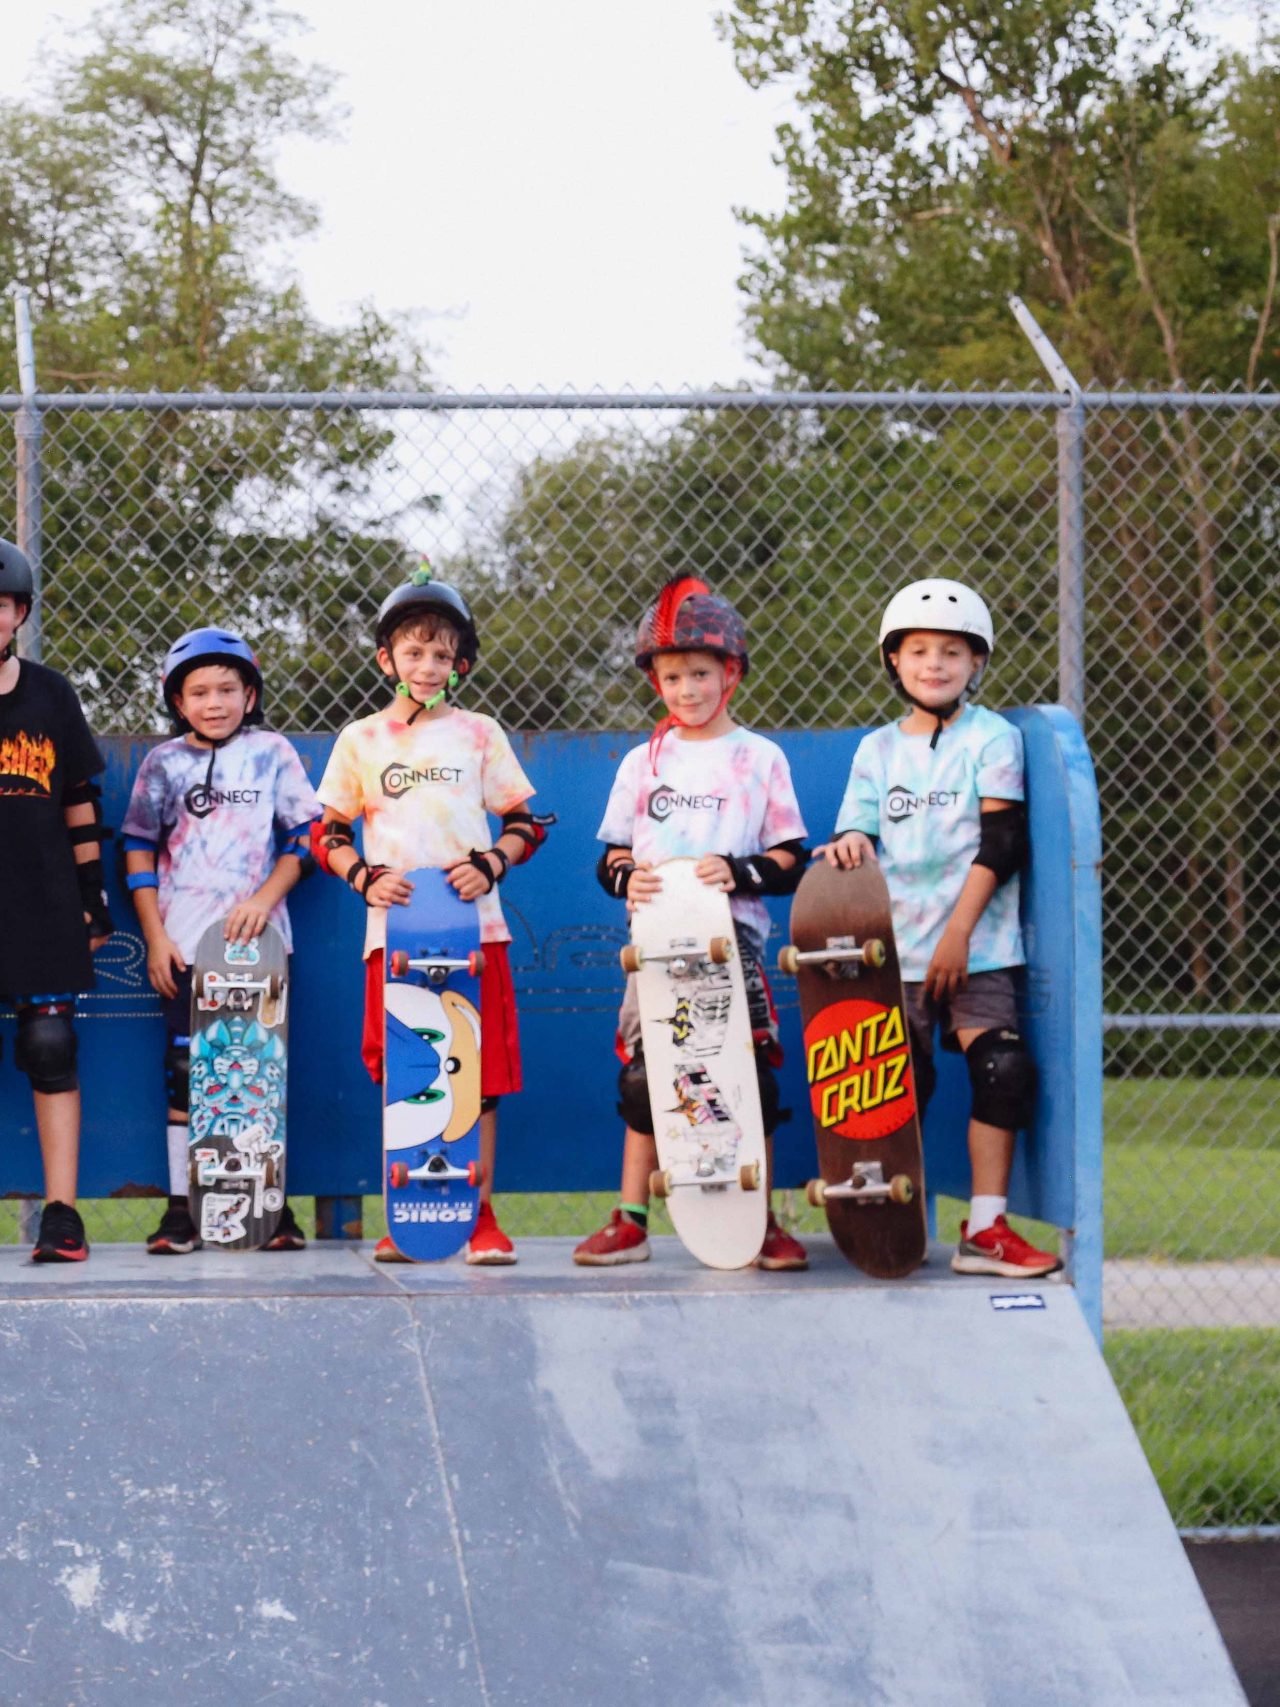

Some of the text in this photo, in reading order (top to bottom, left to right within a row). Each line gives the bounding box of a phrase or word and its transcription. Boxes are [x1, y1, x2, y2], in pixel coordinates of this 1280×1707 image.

[380, 762, 464, 799] CONNECT
[184, 783, 261, 820] CONNECT
[647, 784, 726, 823] CONNECT
[807, 1006, 905, 1084] SANTA
[821, 1053, 908, 1128] CRUZ
[393, 1209, 473, 1223] SONIC
